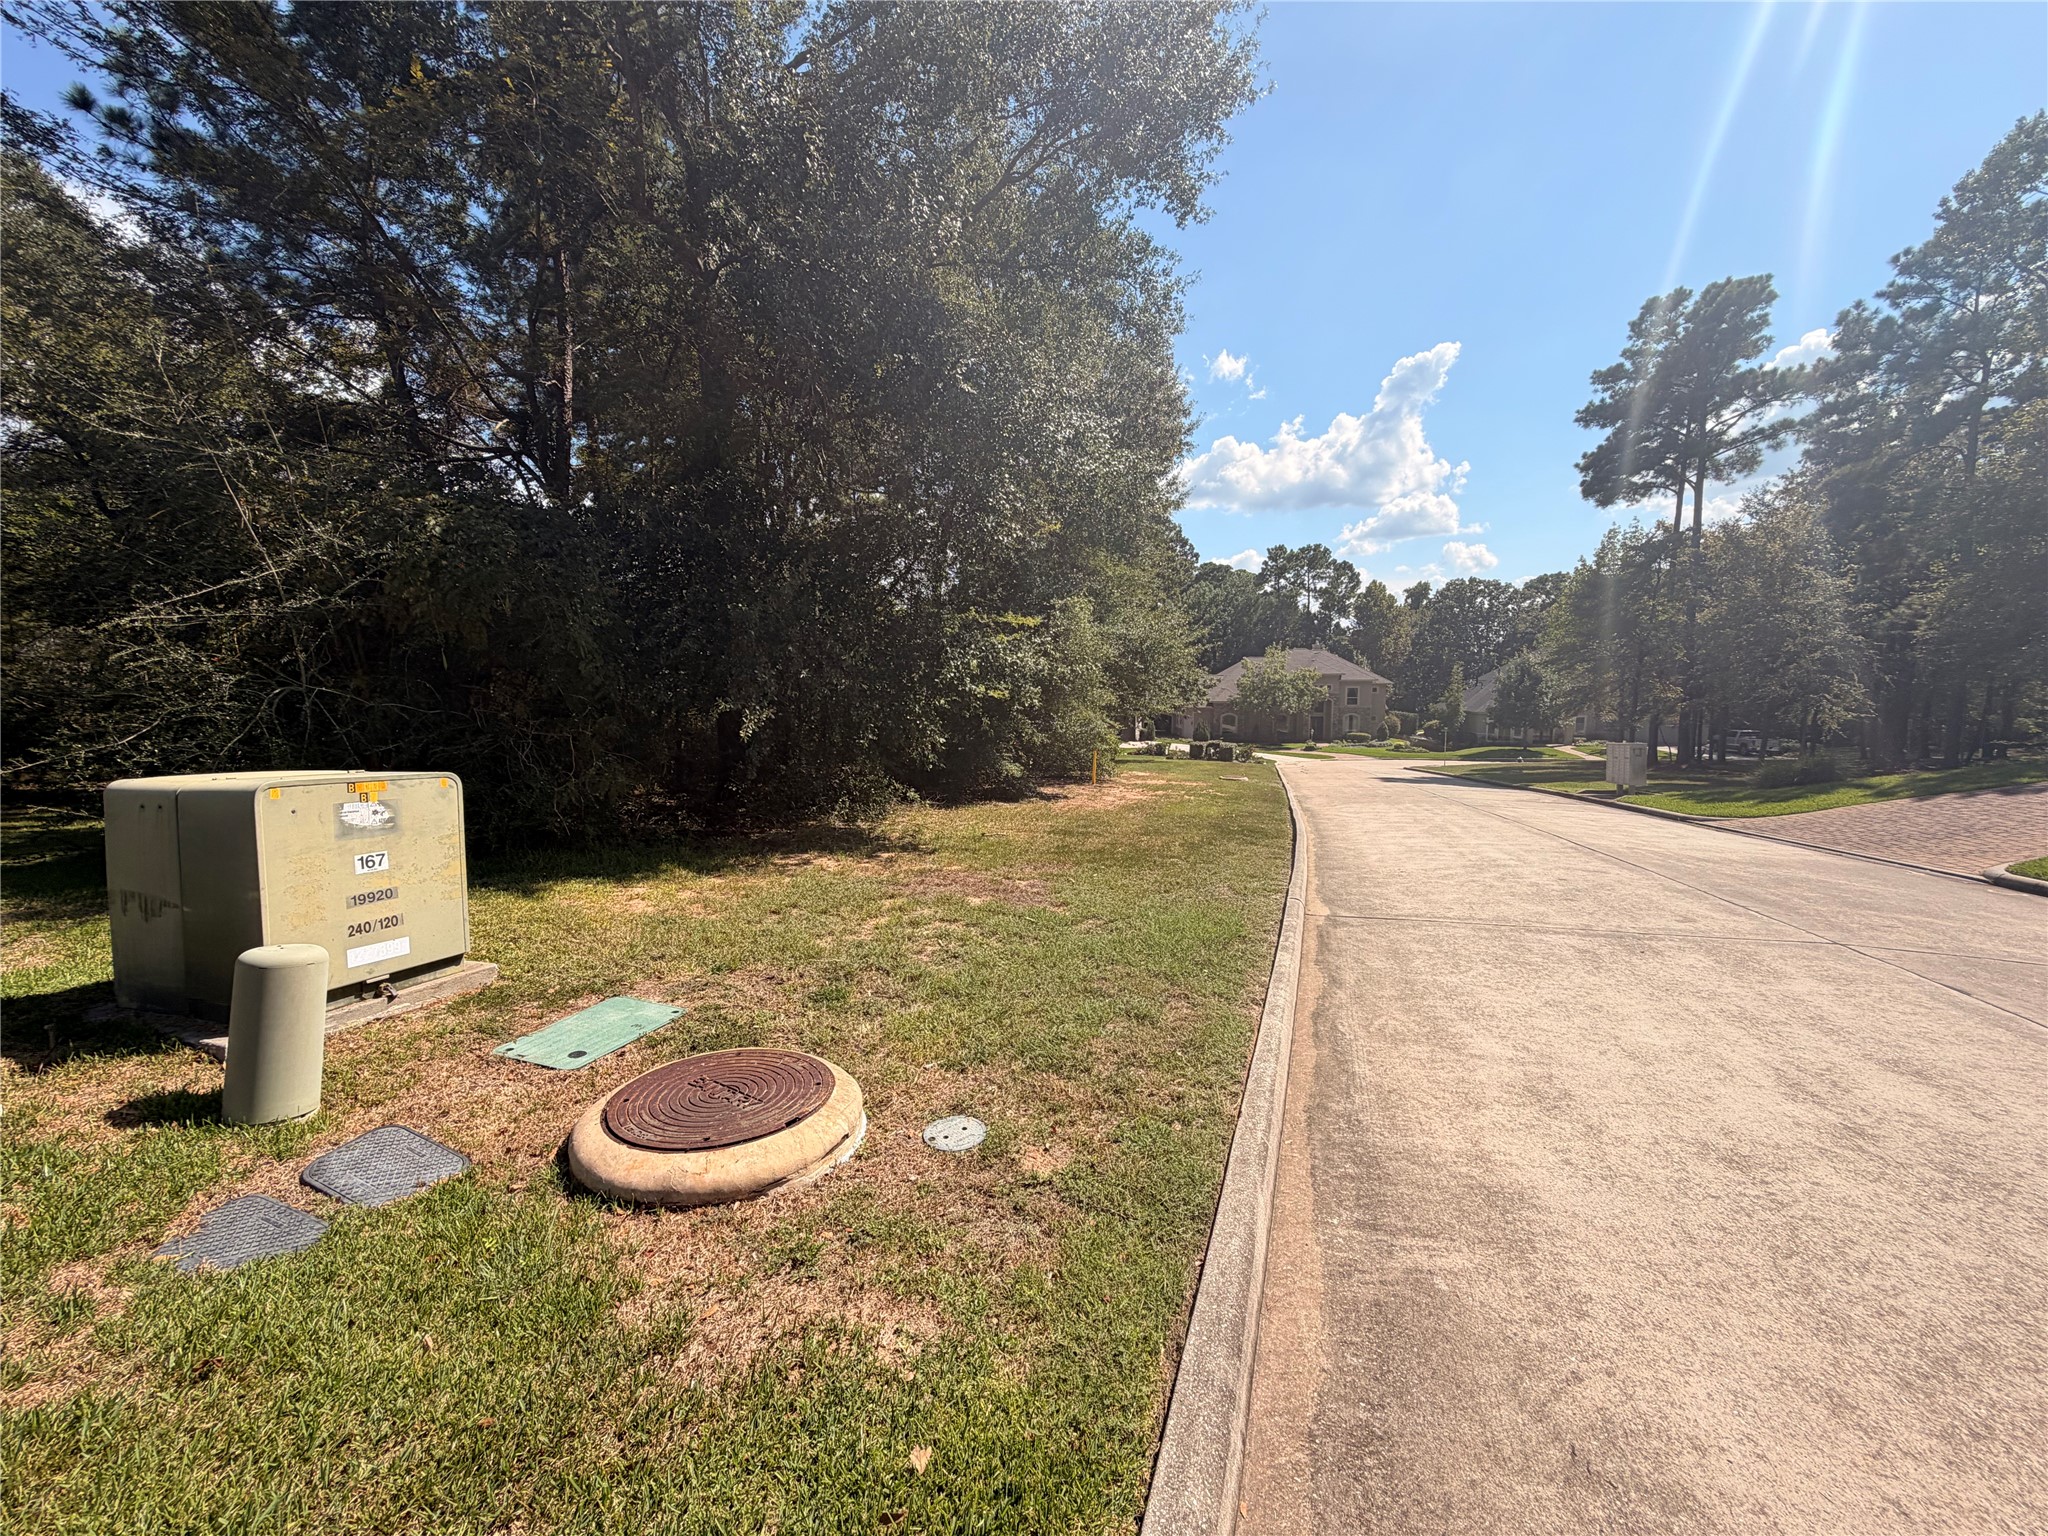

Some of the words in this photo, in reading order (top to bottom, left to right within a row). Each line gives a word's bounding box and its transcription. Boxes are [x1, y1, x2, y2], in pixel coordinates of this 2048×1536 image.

[360, 793, 367, 802] B
[357, 853, 386, 870] 167
[351, 888, 393, 906] 19920
[347, 915, 399, 938] 240/120
